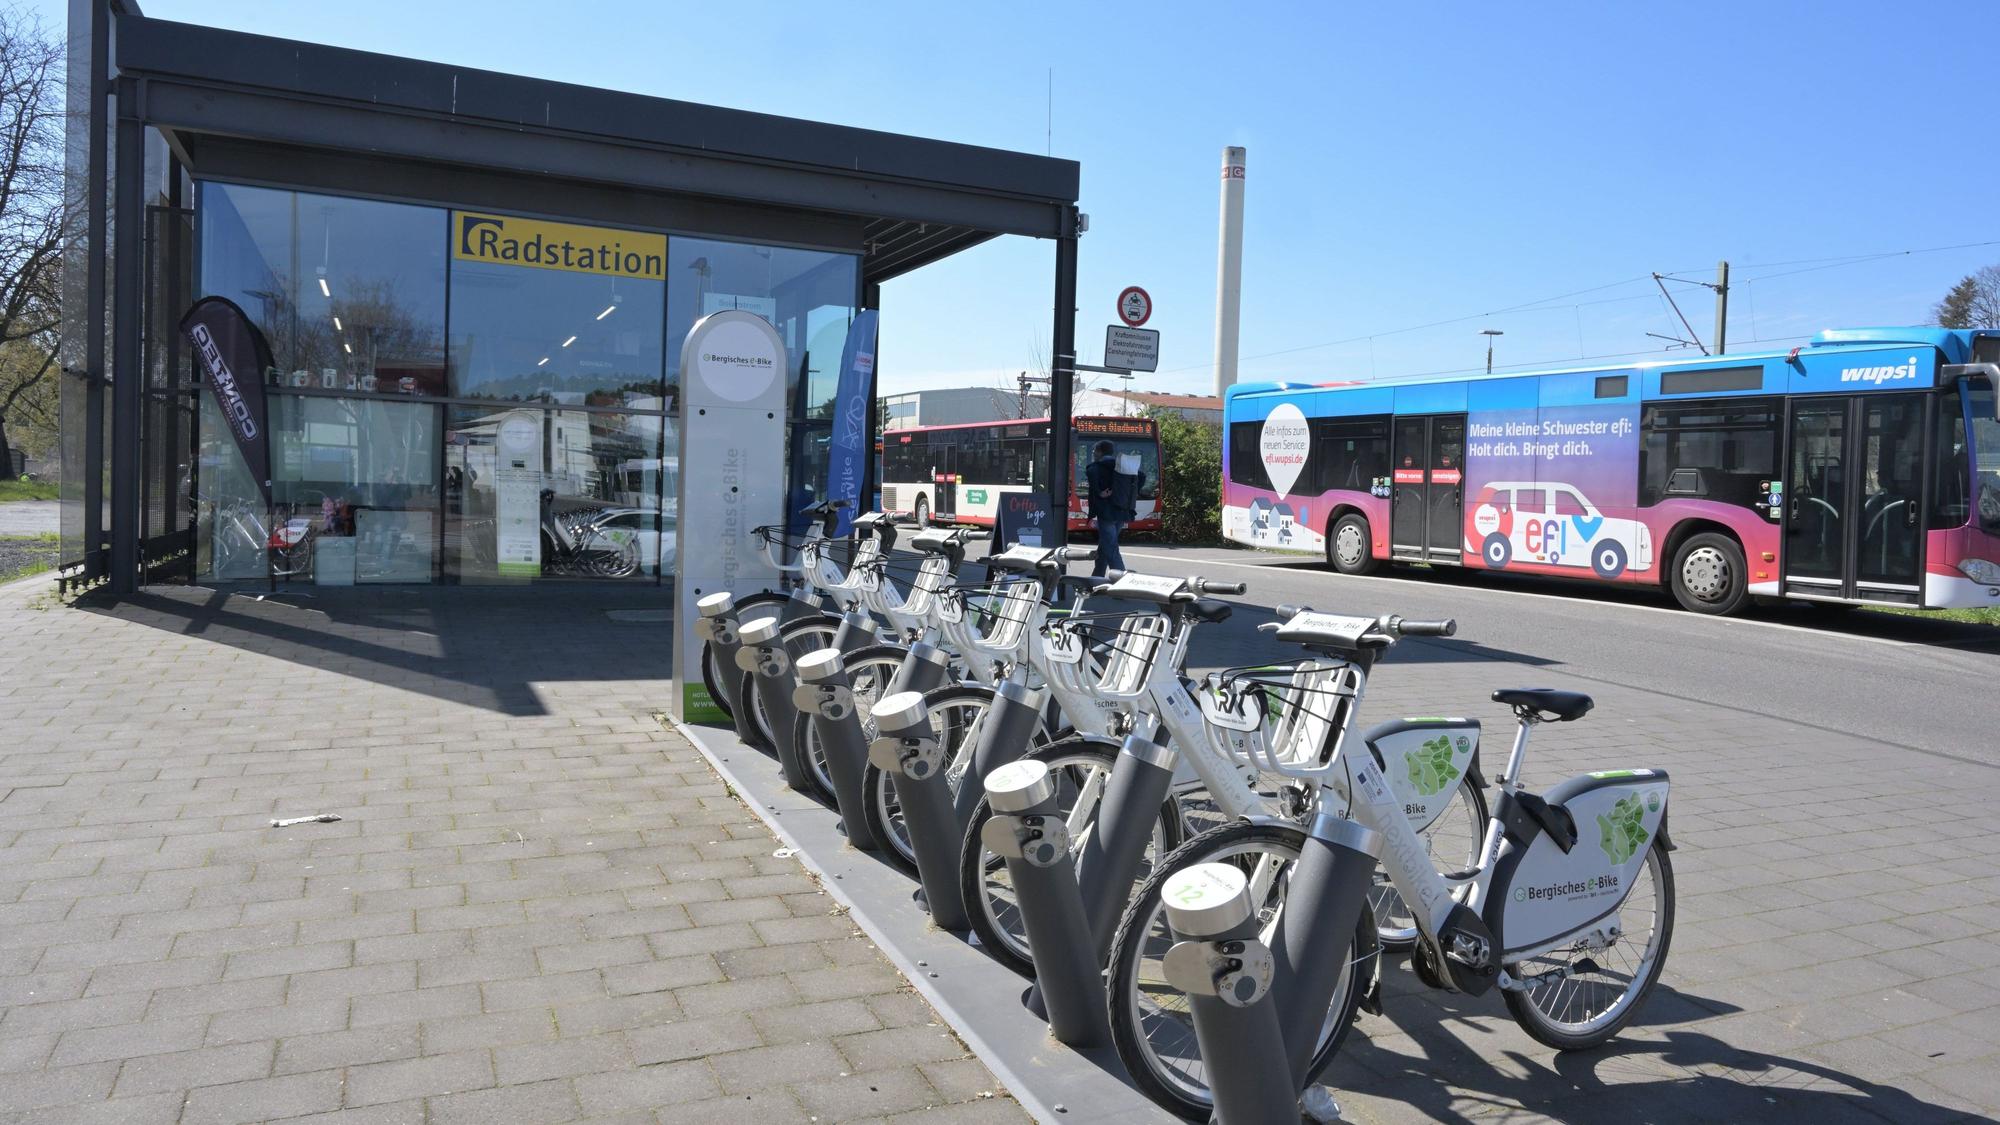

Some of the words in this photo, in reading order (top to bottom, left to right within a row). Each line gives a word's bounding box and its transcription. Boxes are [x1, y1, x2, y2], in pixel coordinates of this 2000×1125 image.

[479, 228, 662, 276] Radstation
[711, 354, 749, 364] Bergisches
[1840, 356, 1917, 385] wupsi
[1264, 425, 1276, 436] Alle
[1292, 427, 1307, 436] zum
[1469, 424, 1503, 438] Meine
[1505, 422, 1540, 437] kleine
[1543, 420, 1608, 436] Schwester
[1611, 418, 1632, 437] efi:
[1264, 440, 1282, 449] neuen
[1469, 443, 1491, 457] Holt
[1493, 442, 1520, 457] dich.
[1523, 441, 1560, 460] Bringt
[1562, 440, 1593, 456] dich.
[1265, 453, 1303, 466] efi.wupsi.de
[721, 506, 739, 594] ergisches
[1402, 803, 1426, 815] -Bike
[1528, 881, 1586, 901] Bergisches
[1587, 874, 1618, 891] e-Bike
